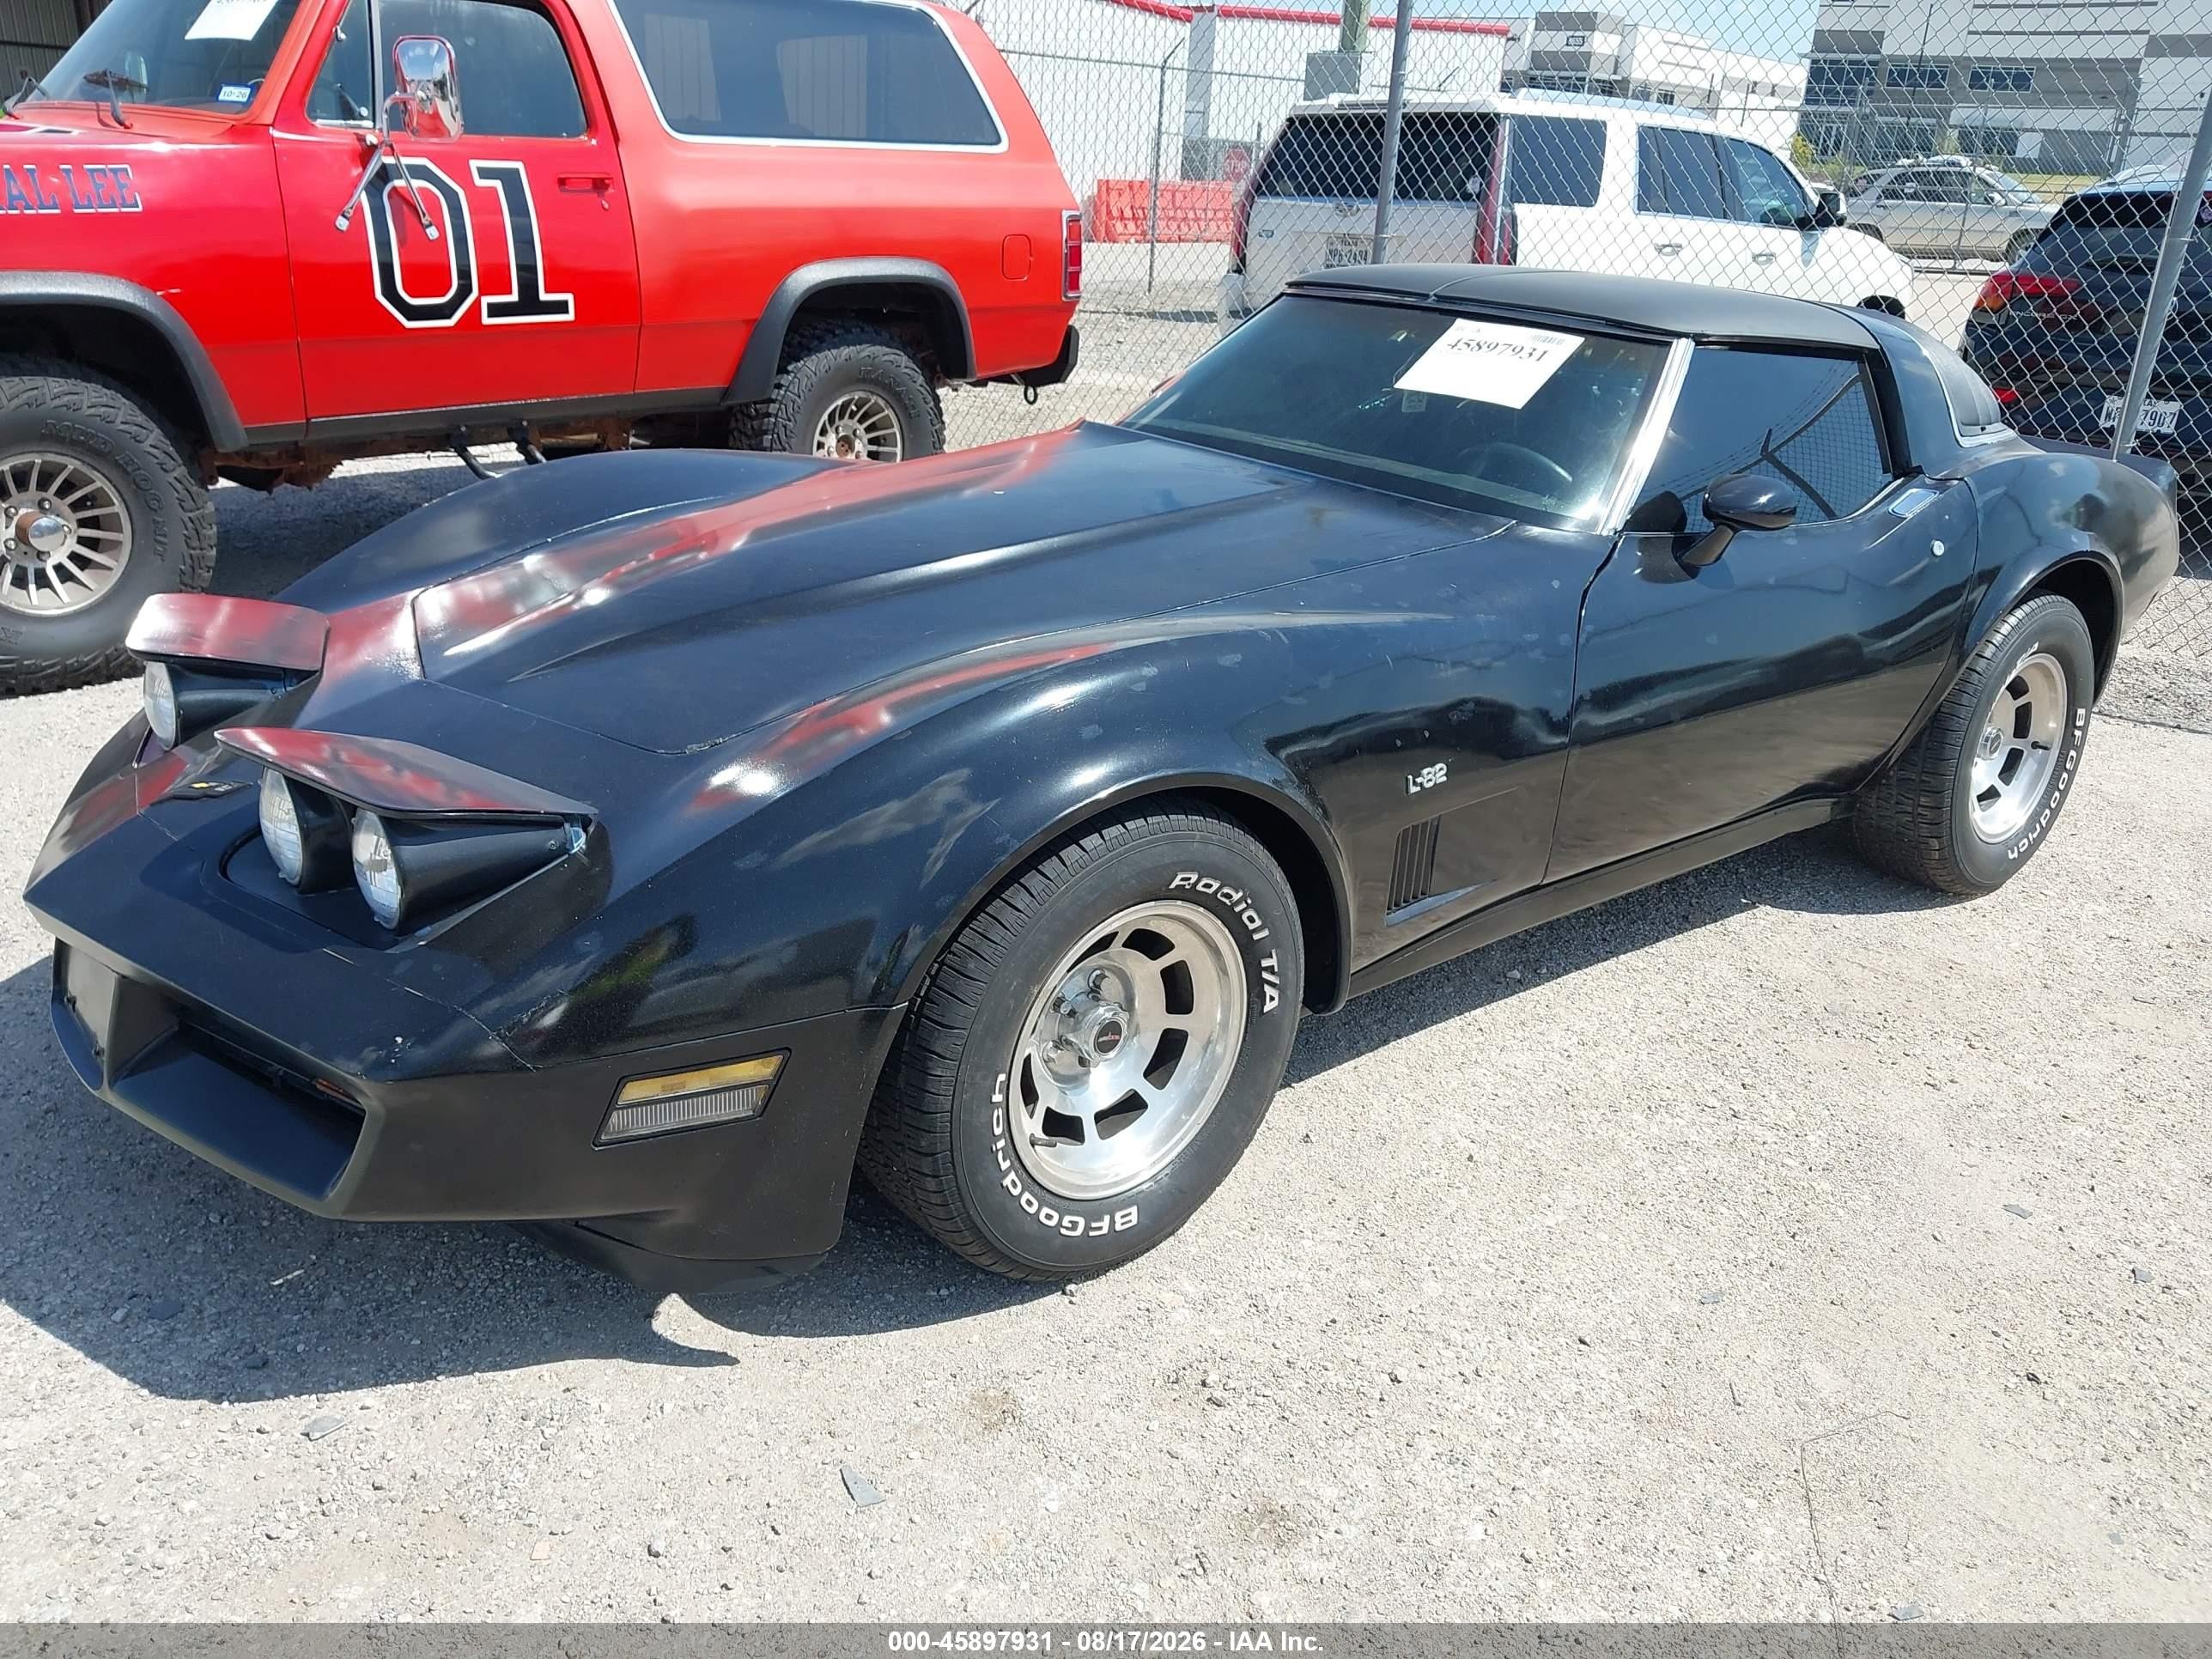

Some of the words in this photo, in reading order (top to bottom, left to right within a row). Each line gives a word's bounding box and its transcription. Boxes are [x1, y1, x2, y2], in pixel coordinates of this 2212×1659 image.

[0, 164, 61, 215] AL
[59, 164, 143, 214] LEE
[359, 155, 575, 328] 01
[1447, 337, 1549, 362] 45897931
[2009, 310, 2055, 319] ENCORE
[1407, 763, 1448, 794] L-82
[2008, 708, 2086, 860] BFGoodrich
[1169, 872, 1270, 941] Radial
[1261, 948, 1280, 1014] T/A
[991, 1073, 1139, 1237] BFGoodrich
